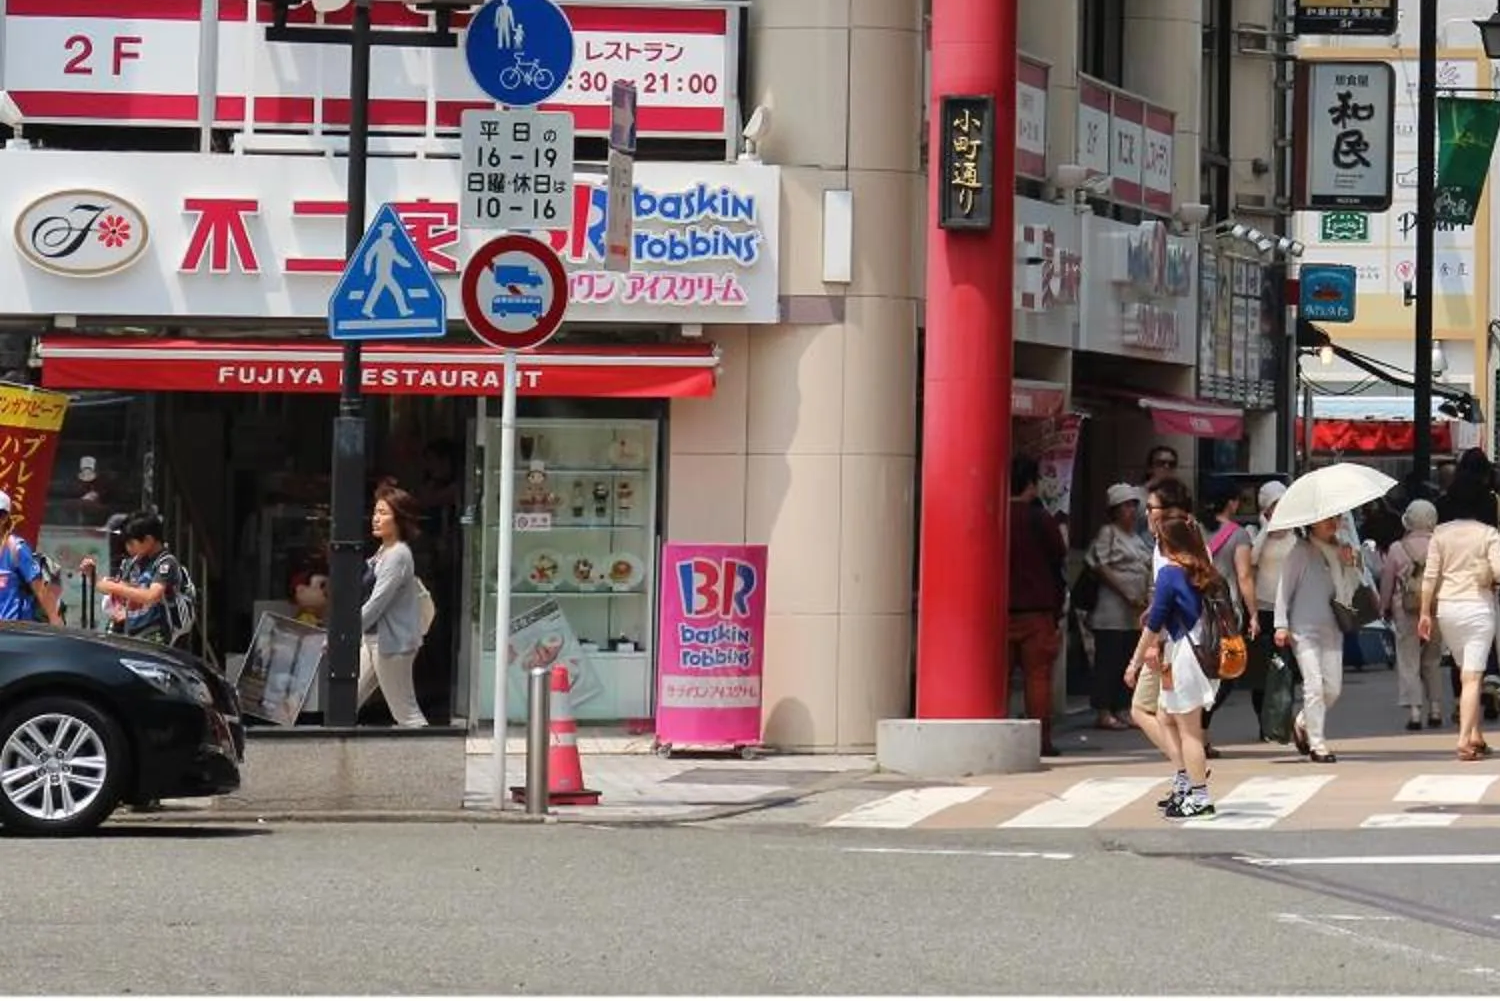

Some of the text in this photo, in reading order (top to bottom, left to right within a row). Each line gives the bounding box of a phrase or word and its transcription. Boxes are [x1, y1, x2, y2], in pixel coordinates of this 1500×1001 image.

[63, 34, 142, 75] 2F
[585, 40, 684, 63] レストラン
[643, 73, 717, 94] 21:00
[480, 121, 556, 143] 平日の
[1328, 90, 1374, 169] 和民
[476, 148, 557, 168] 16-19
[951, 108, 982, 216] 小町通り
[476, 197, 556, 219] 10-16
[633, 183, 754, 220] baskin
[634, 229, 758, 262] robbins
[627, 274, 744, 301] アイスクリーム
[218, 366, 542, 388] FUJIYA ESTAURAT
